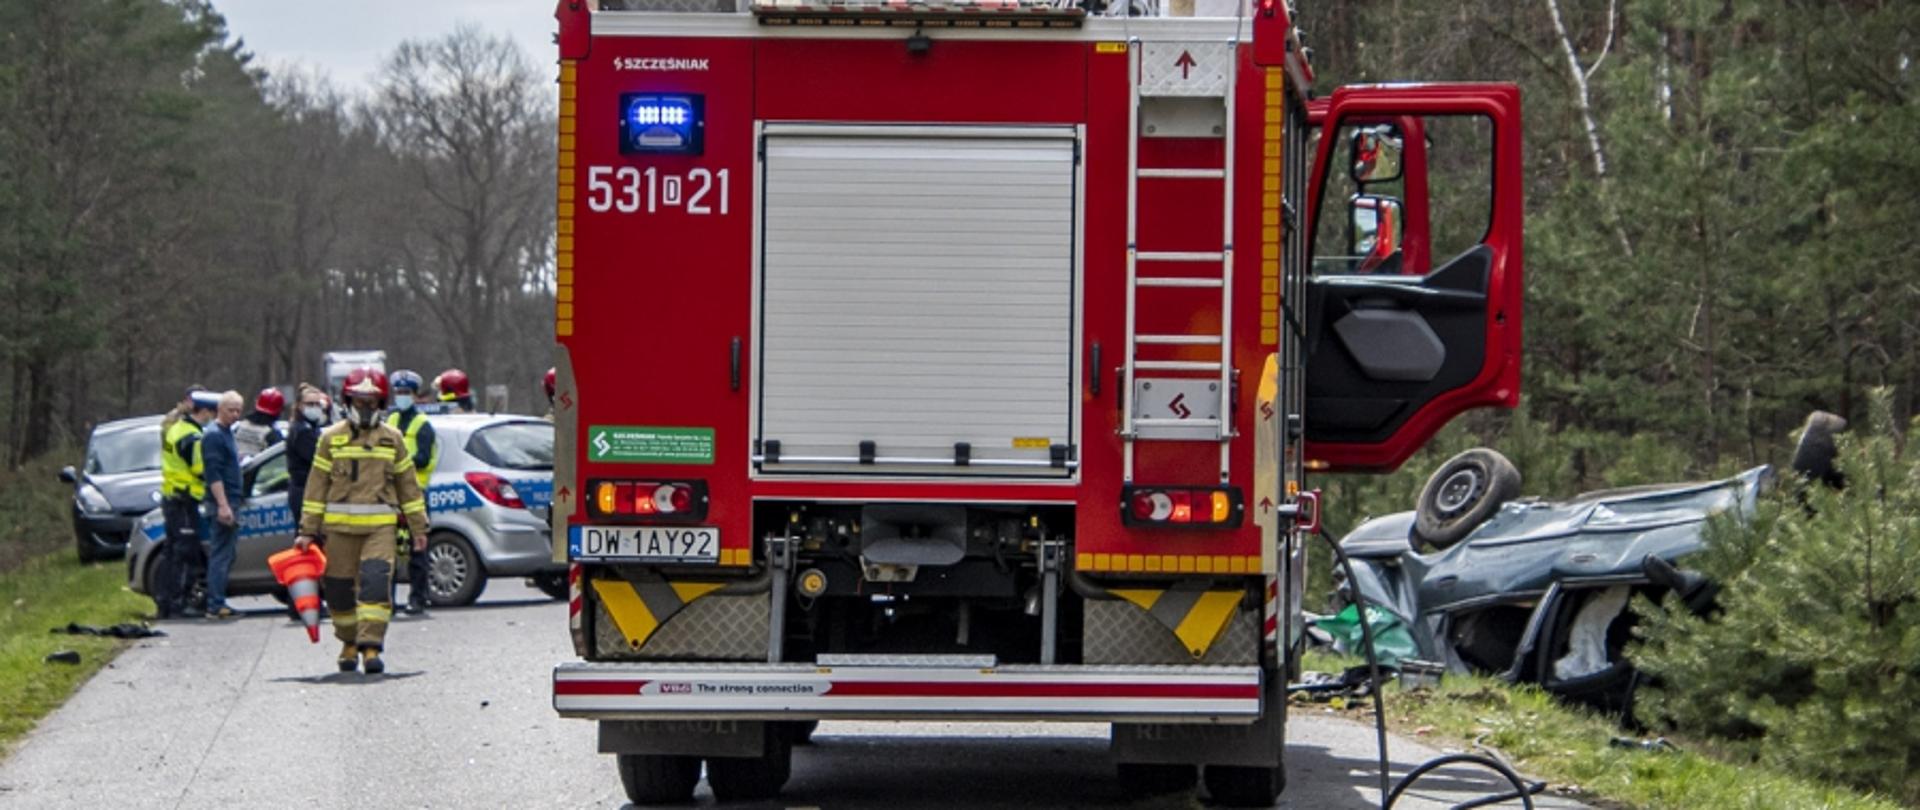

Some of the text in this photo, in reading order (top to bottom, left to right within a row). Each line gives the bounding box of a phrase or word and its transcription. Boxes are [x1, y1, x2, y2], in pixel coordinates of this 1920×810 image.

[587, 166, 656, 213] 531
[687, 167, 729, 214] 21
[429, 489, 466, 508] B998
[587, 530, 620, 554] DW
[634, 530, 712, 556] 1AY92
[698, 684, 716, 693] The
[719, 684, 753, 695] strong
[757, 684, 813, 693] connection
